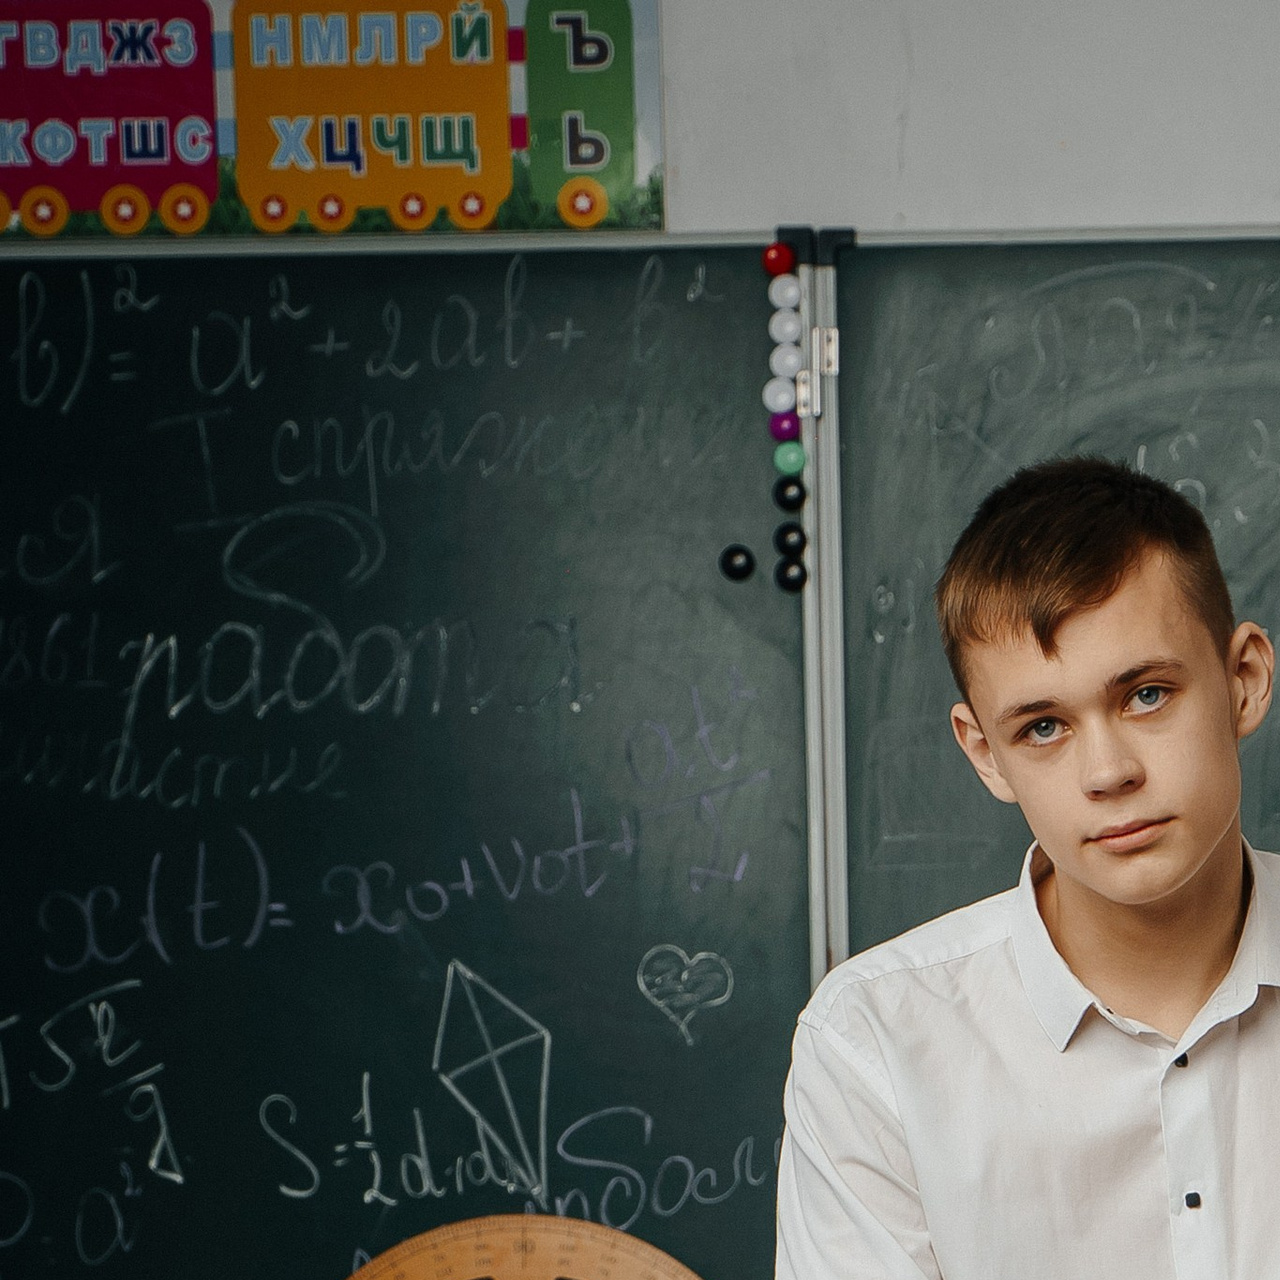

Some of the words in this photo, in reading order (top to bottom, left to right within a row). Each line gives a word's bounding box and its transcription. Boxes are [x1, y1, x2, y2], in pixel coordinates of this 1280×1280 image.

[248, 3, 494, 69] НМЛРЙ
[550, 10, 614, 71] Ъ
[268, 111, 482, 177] ХЦЧЩ
[561, 111, 609, 172] Ь
